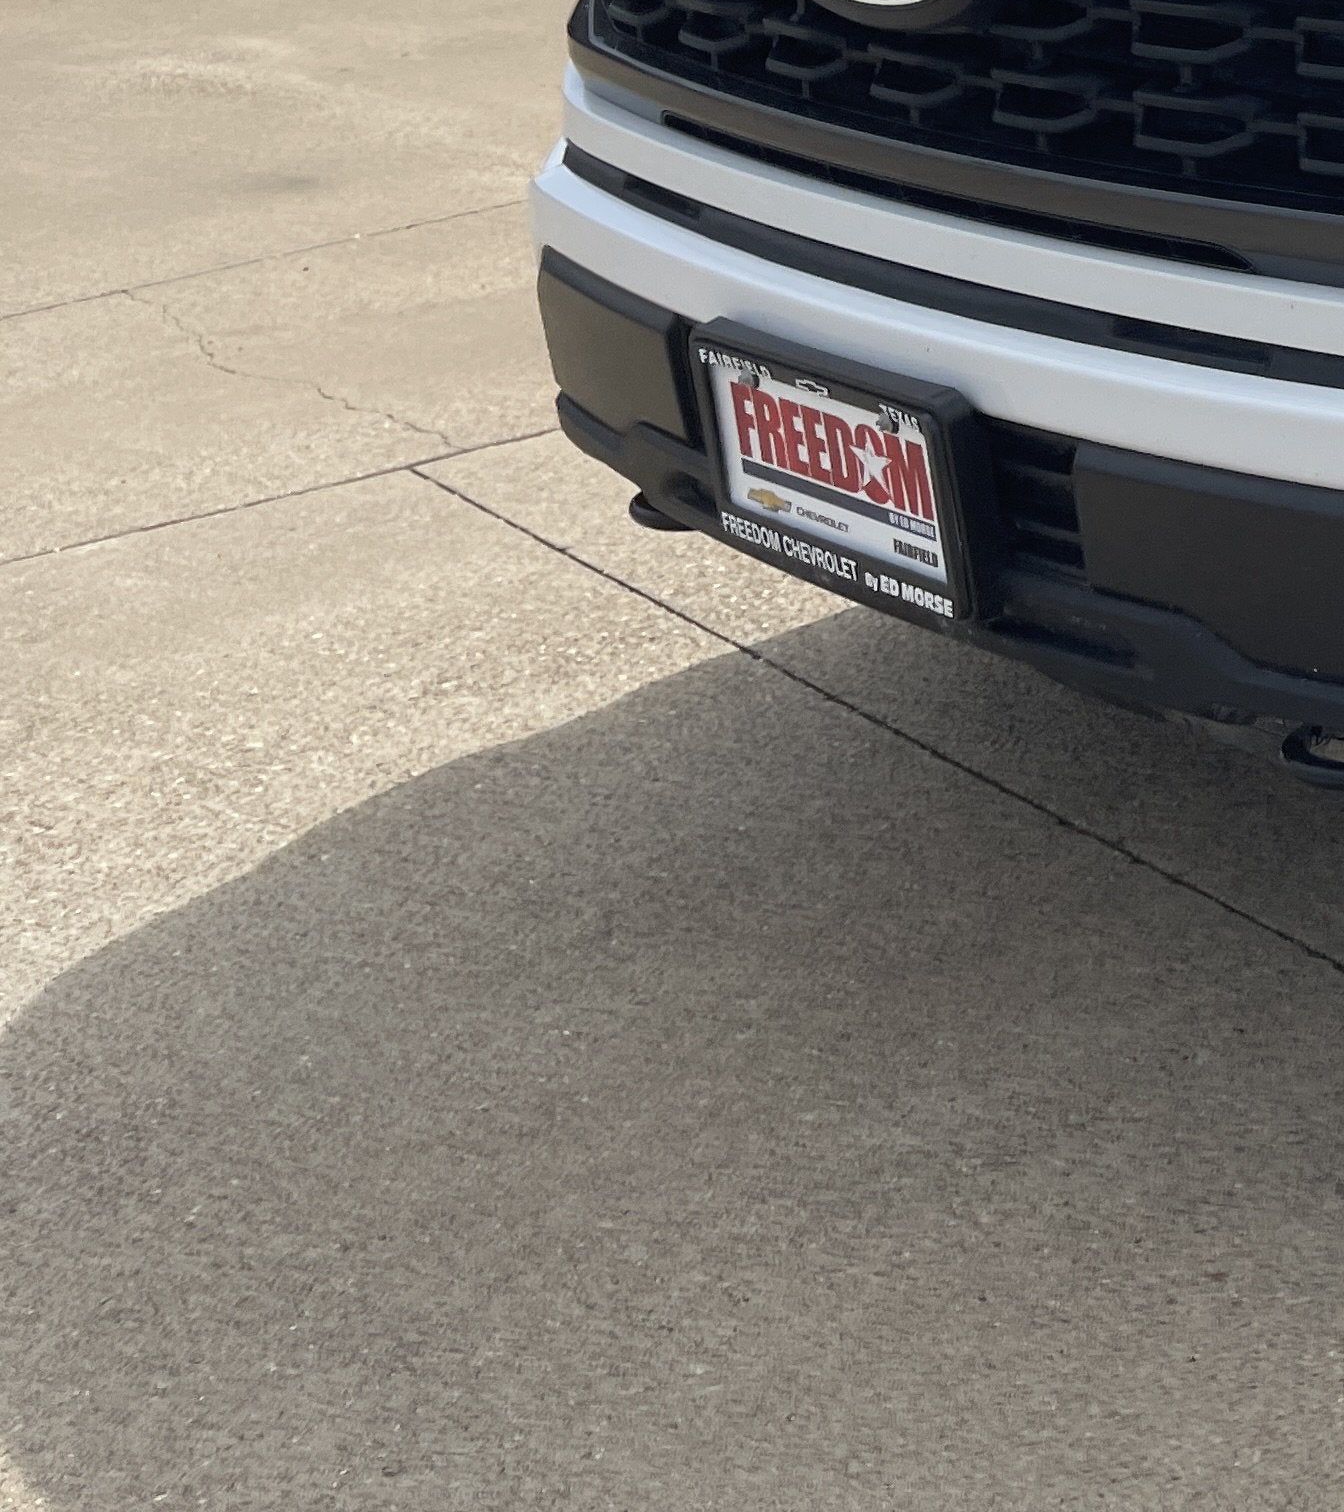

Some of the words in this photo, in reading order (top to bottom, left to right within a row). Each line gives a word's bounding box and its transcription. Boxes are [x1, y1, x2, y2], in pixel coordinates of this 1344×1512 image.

[698, 348, 773, 381] FAIRFIELD
[878, 402, 920, 432] TEXAS
[730, 381, 935, 522] FREEDOM
[721, 511, 782, 553] FREEDOM
[782, 535, 857, 582] CHEVROLET
[879, 574, 899, 598] ED
[901, 582, 954, 619] MORSE
